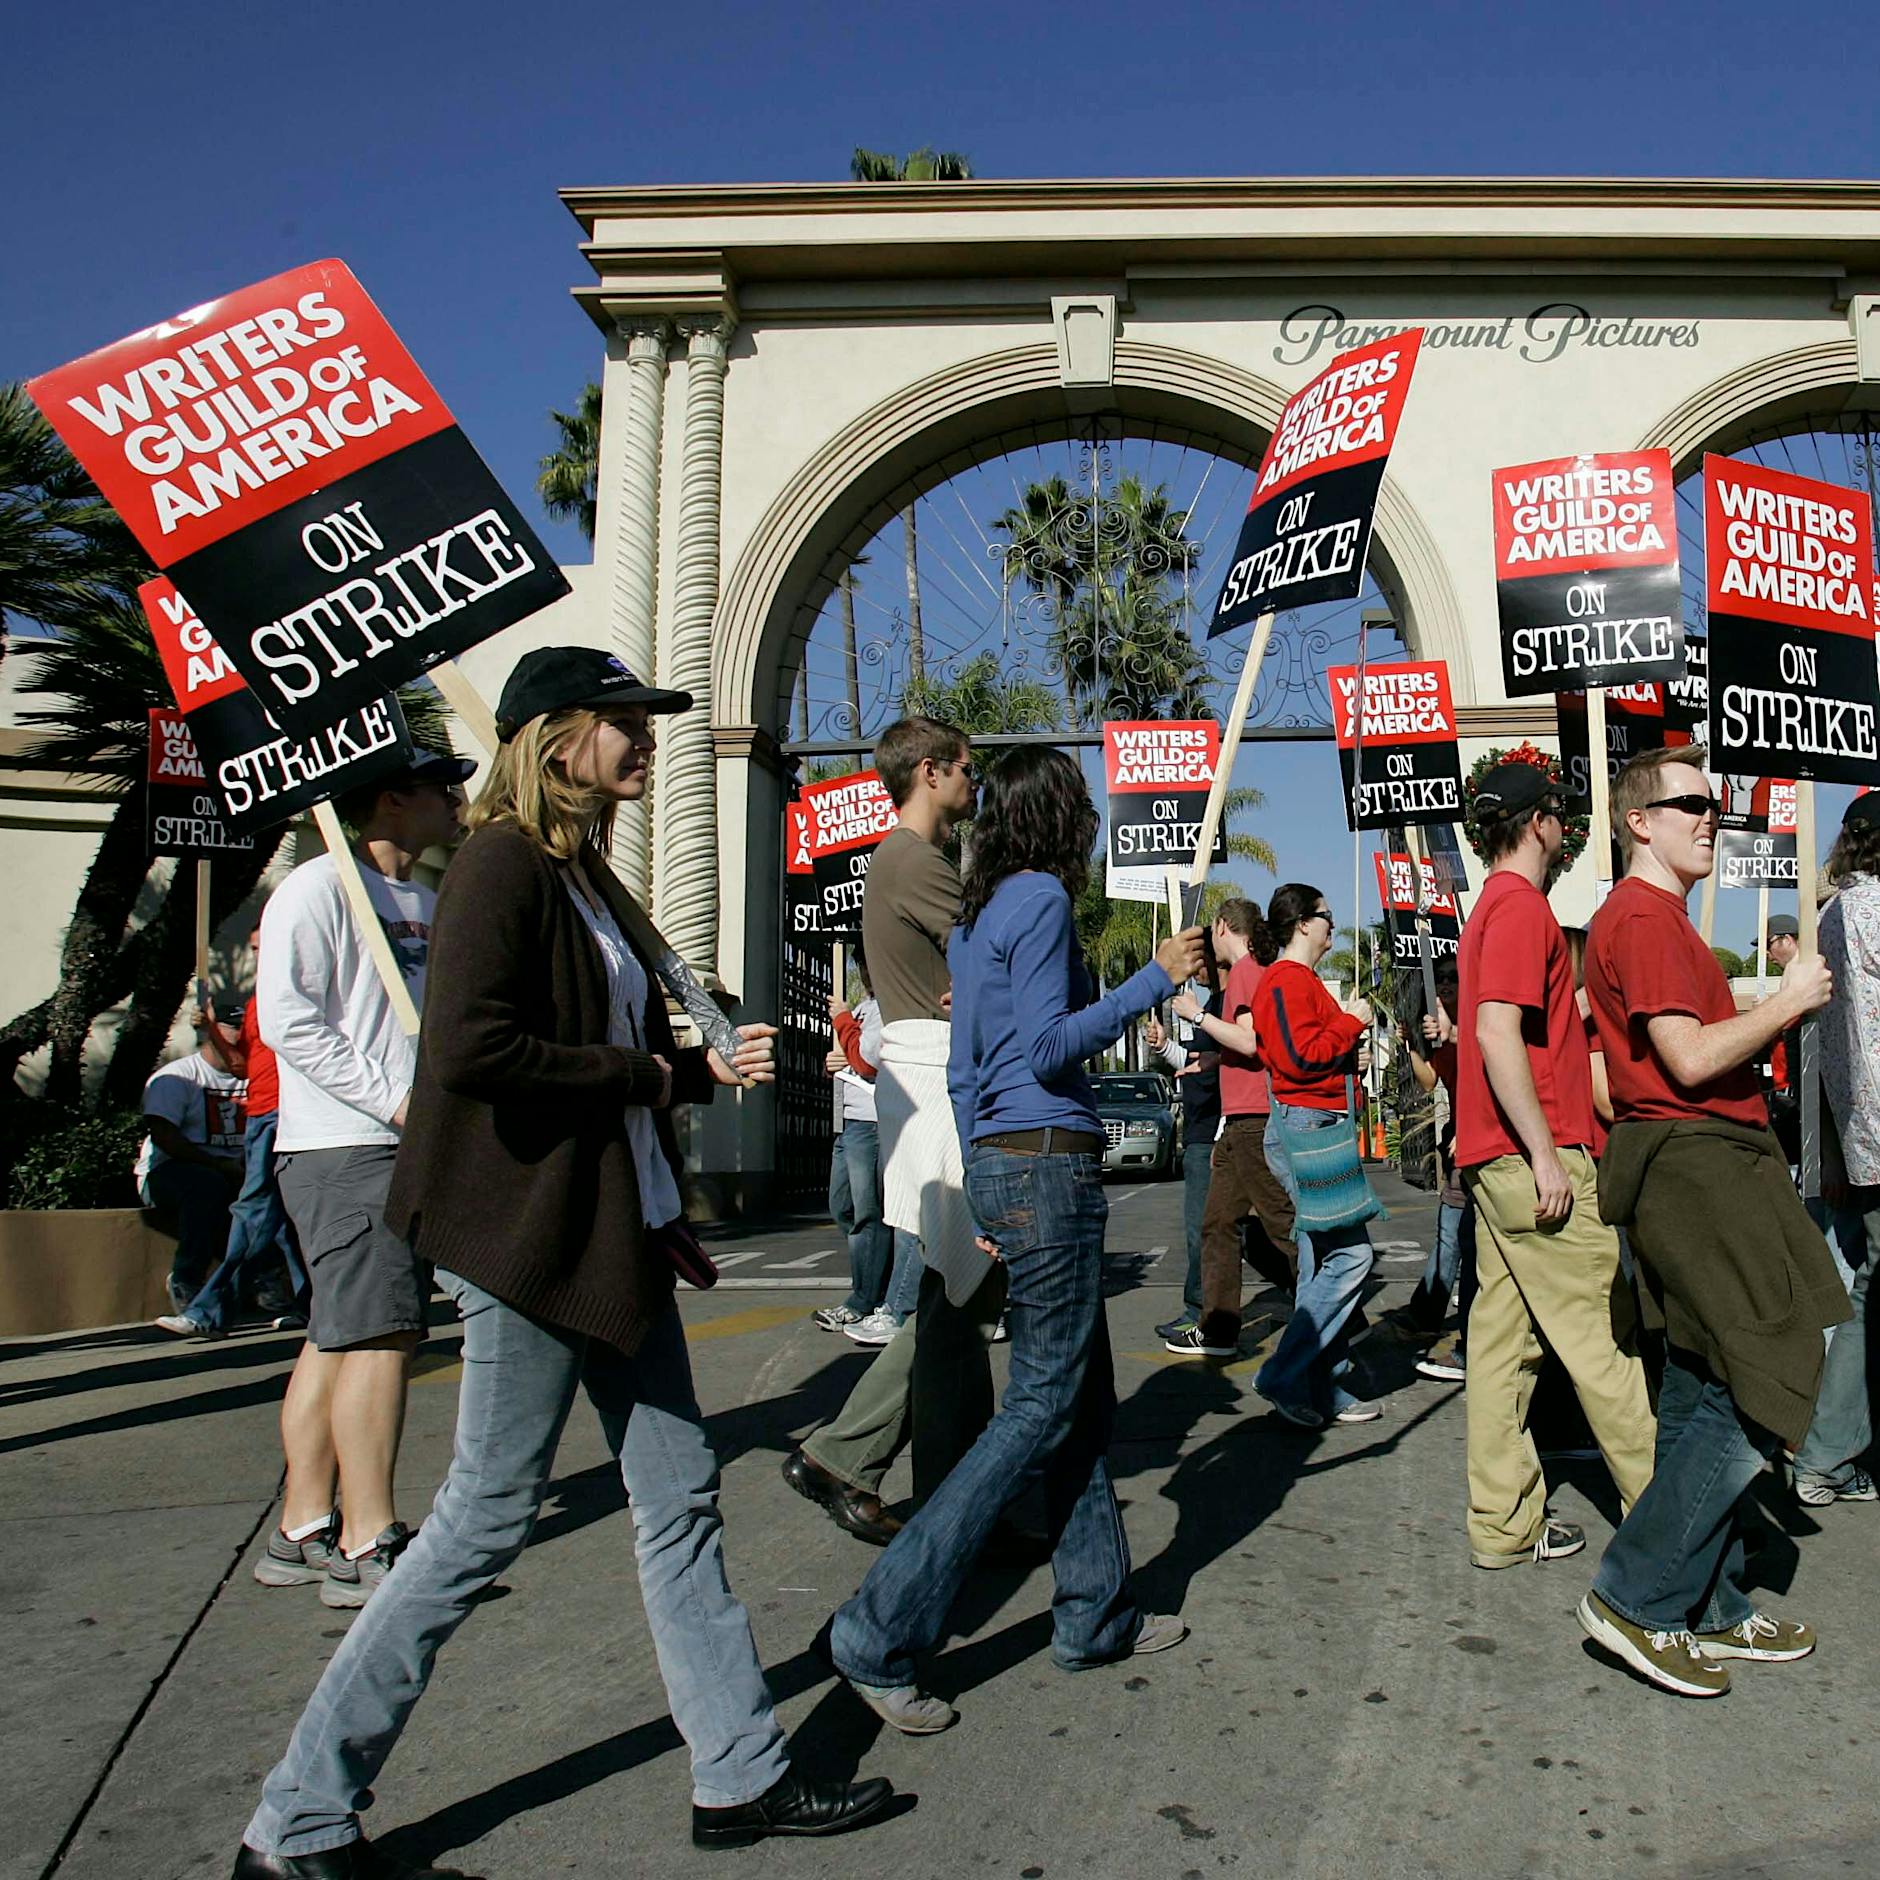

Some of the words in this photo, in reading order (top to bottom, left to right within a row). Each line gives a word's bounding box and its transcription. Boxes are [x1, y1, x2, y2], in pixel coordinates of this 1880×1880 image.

[1273, 304, 1513, 365] Paraount
[1520, 303, 1700, 363] Pictures
[67, 291, 345, 436] WRITERS
[124, 367, 309, 475] GUILD
[309, 345, 368, 391] OF
[1282, 351, 1400, 430] WRITERS
[1274, 396, 1353, 458] GUILD
[1352, 391, 1388, 419] OF
[150, 377, 422, 535] AMERICA
[1258, 415, 1385, 494] AMERICA
[1504, 467, 1654, 507] WRITERS
[1276, 492, 1315, 536] ON
[1513, 498, 1617, 534] GUILD
[1617, 502, 1653, 523] OF
[1716, 479, 1856, 543] WRITERS
[301, 501, 383, 573] ON
[1507, 525, 1665, 564] AMERICA
[1727, 521, 1825, 572] GUILD
[1827, 551, 1857, 579] OF
[1219, 518, 1360, 614] STRIKE
[250, 508, 535, 705] STRIKE
[1566, 585, 1606, 617] ON
[1720, 558, 1867, 619] AMERICA
[1512, 616, 1675, 676] STRIKE
[1780, 642, 1817, 687] ON
[1337, 672, 1438, 697] WRITERS
[1417, 696, 1438, 712] OF
[1112, 730, 1208, 748] WRITERS
[1722, 685, 1877, 760] STRIKE
[219, 698, 397, 815] STRIKE
[1115, 765, 1216, 784] AMERICA
[1119, 748, 1184, 766] GUILD
[1185, 751, 1207, 764] OF
[1387, 754, 1413, 777] ON
[193, 796, 217, 816] ON
[816, 801, 872, 829] GUILD
[874, 799, 892, 814] OF
[1152, 800, 1179, 820] ON
[1352, 777, 1459, 816] STRIKE
[816, 812, 899, 848] AMERICA
[1118, 823, 1220, 854] STRIK
[1753, 839, 1774, 854] ON
[824, 880, 865, 916] STR
